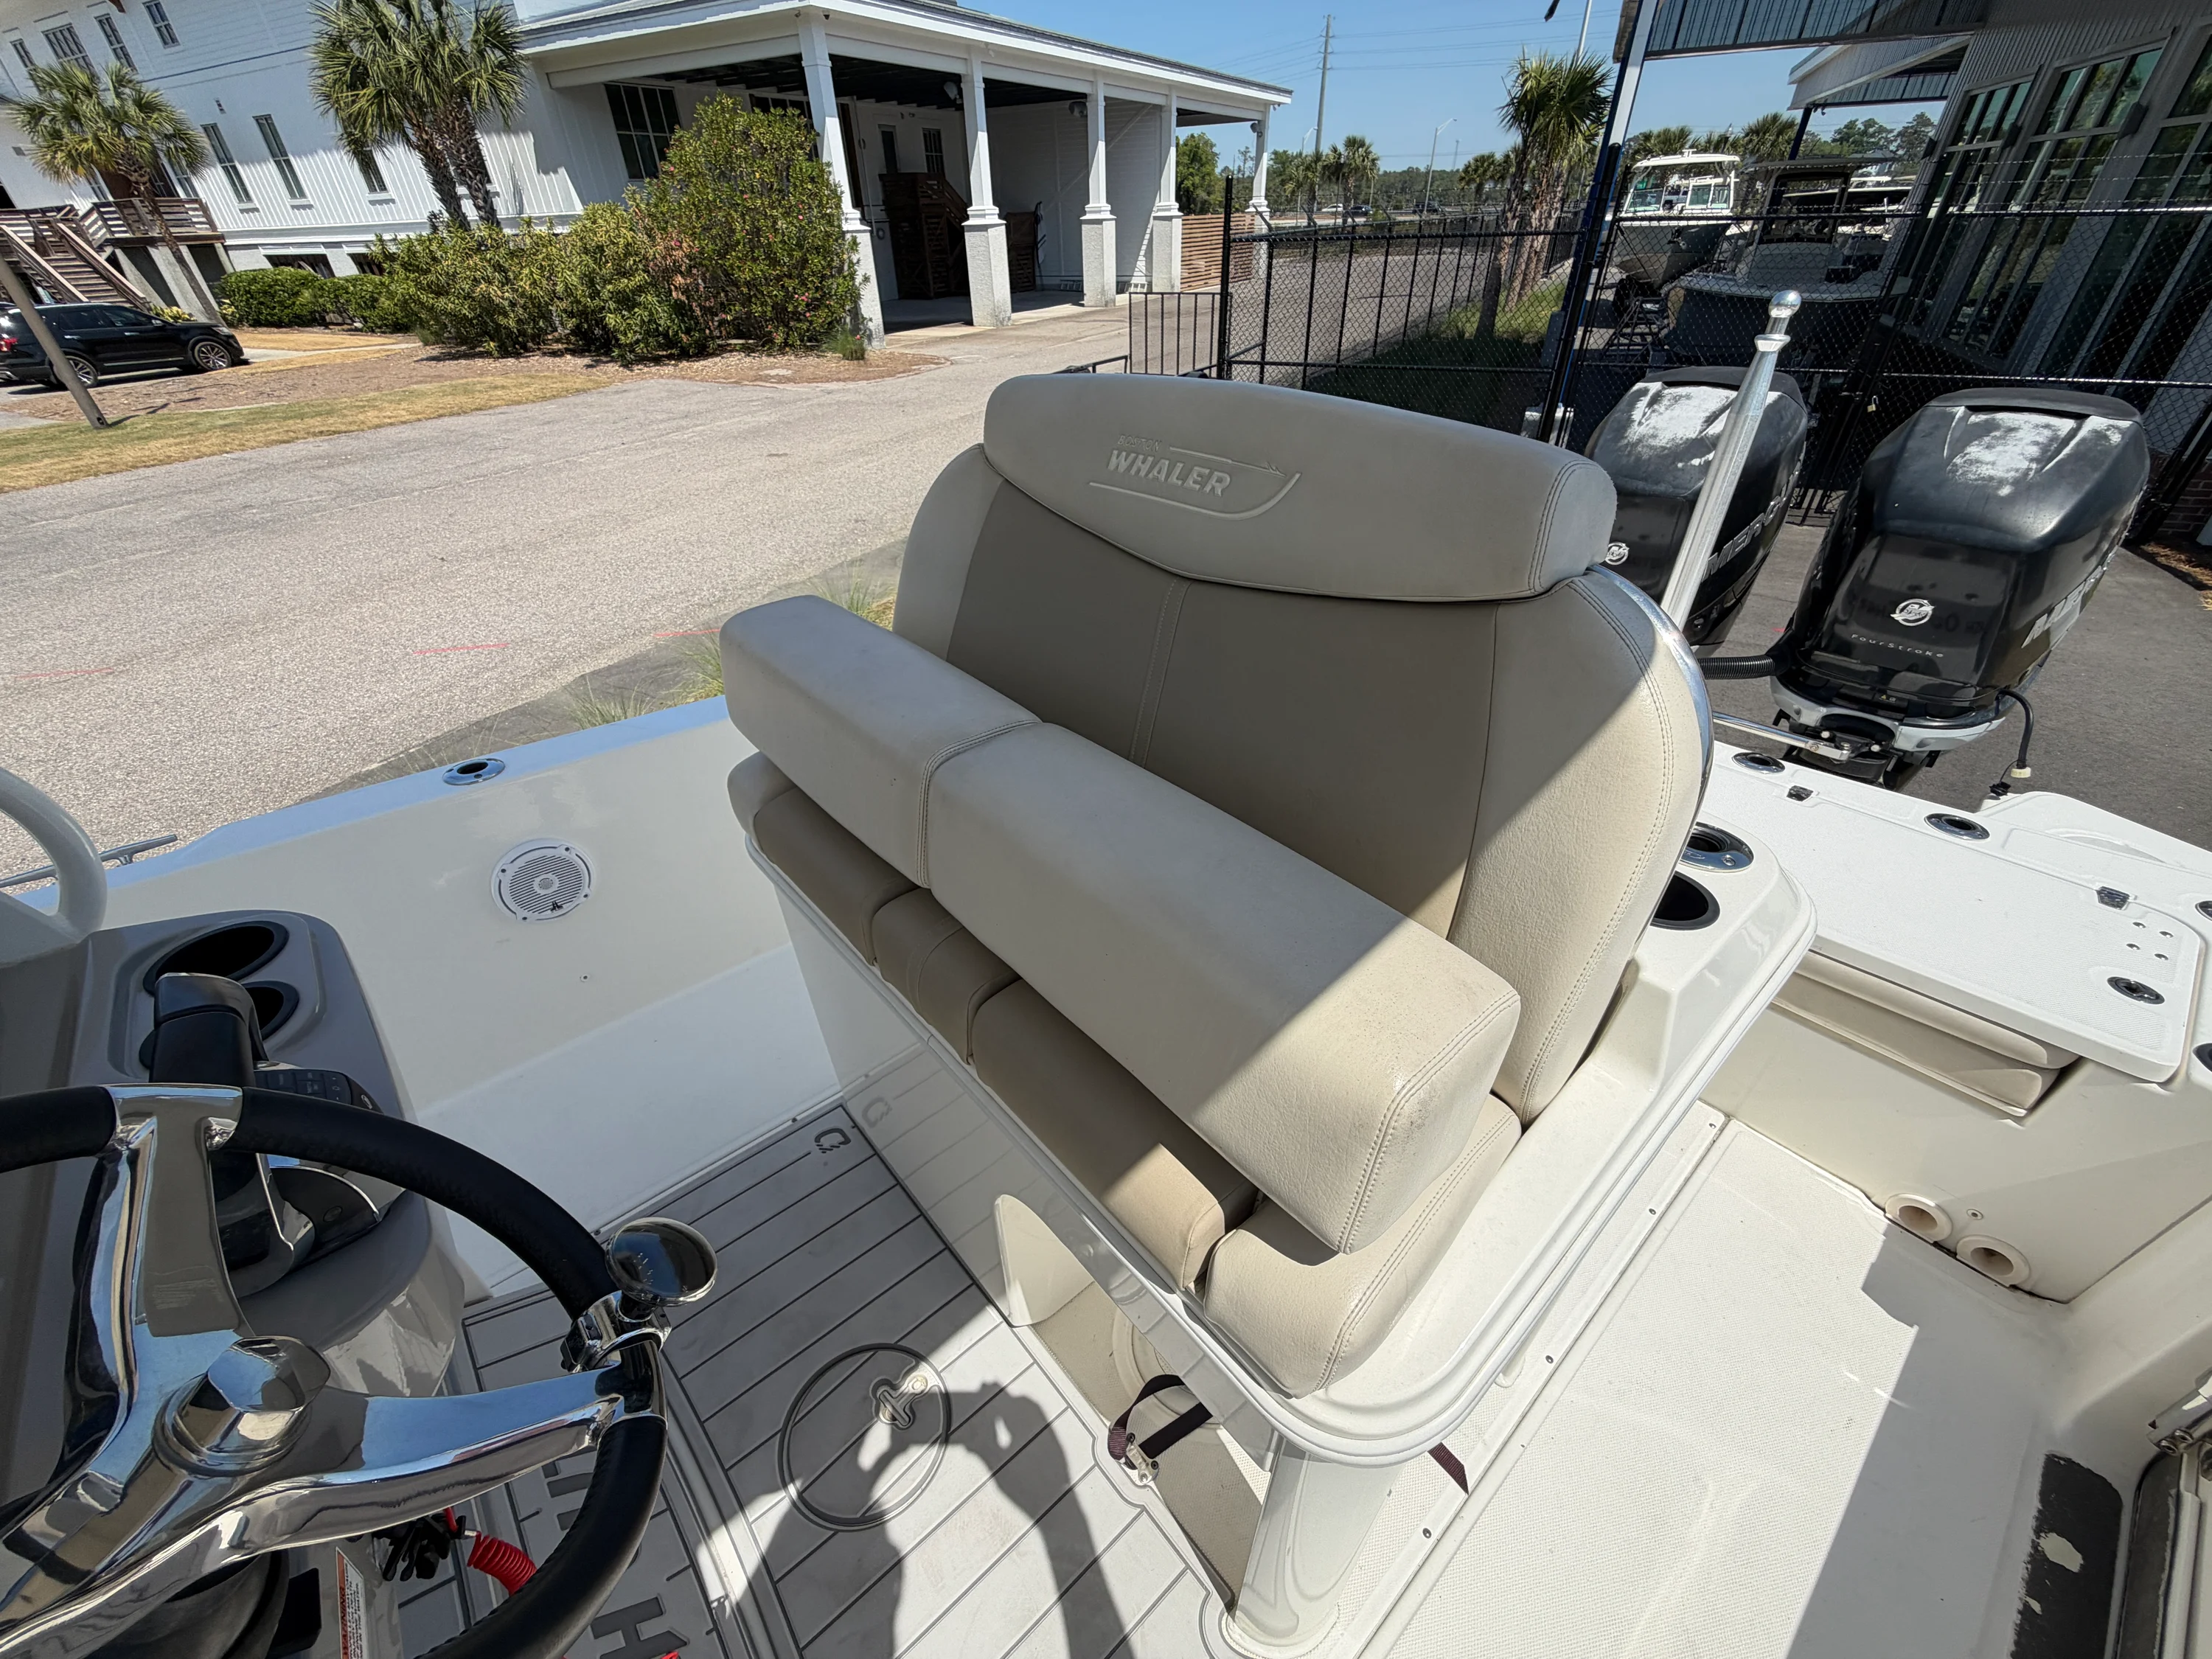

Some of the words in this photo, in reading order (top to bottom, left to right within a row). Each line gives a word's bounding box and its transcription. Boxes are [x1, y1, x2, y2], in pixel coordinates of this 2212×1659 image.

[1118, 435, 1162, 451] BOSTON
[1107, 449, 1232, 497] WHALER
[1701, 441, 1806, 582] MERCU
